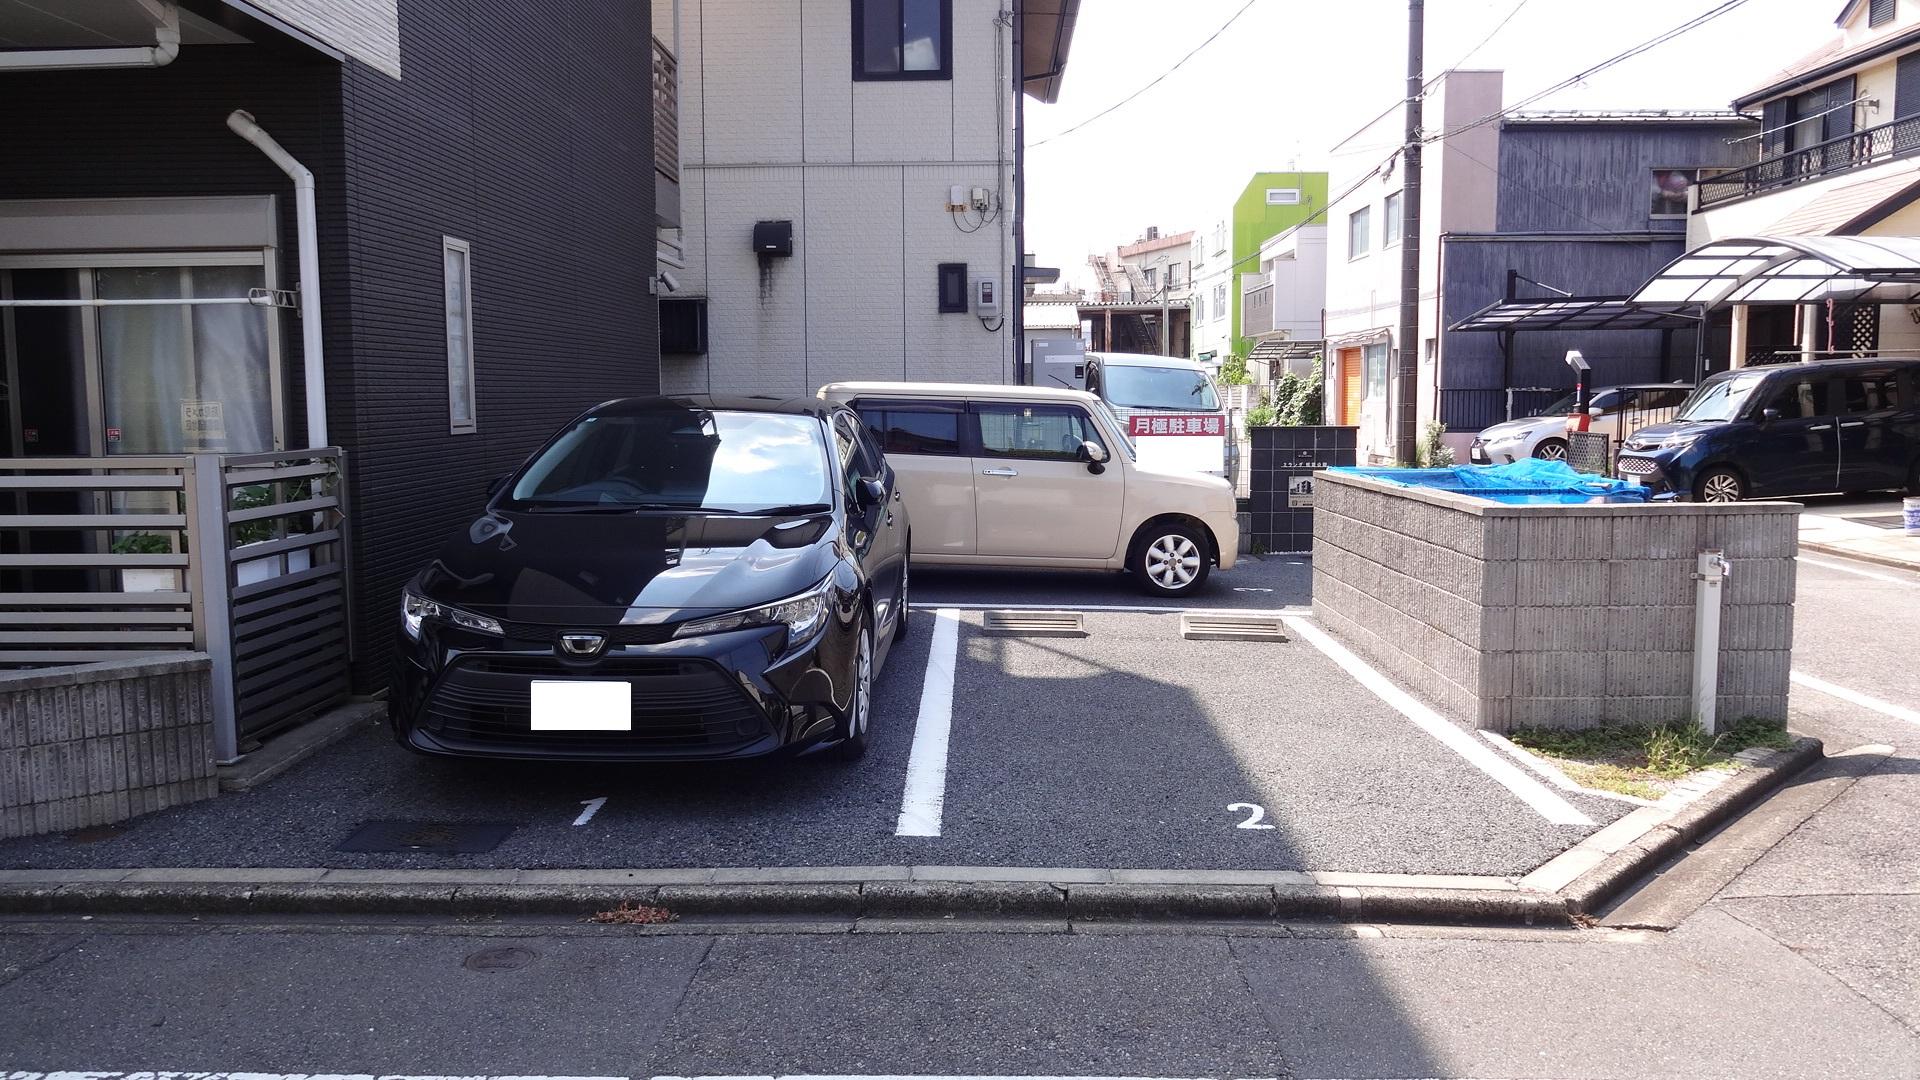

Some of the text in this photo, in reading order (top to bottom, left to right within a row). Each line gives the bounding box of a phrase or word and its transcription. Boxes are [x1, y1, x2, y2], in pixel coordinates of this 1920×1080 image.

[1135, 418, 1219, 433] 月極駐車場
[572, 796, 608, 826] 1
[1226, 802, 1276, 830] 2
